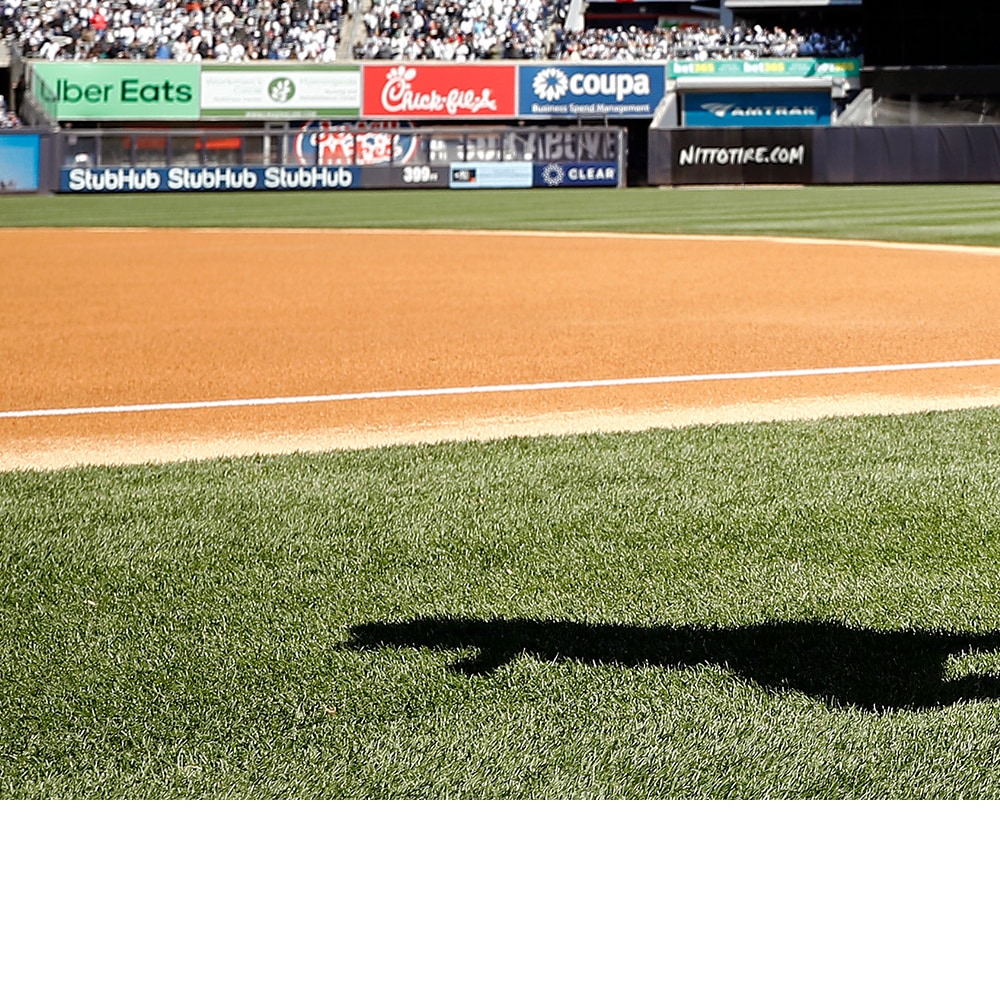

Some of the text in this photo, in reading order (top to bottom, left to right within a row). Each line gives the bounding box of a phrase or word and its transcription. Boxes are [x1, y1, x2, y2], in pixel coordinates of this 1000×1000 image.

[121, 79, 192, 103] Eats
[381, 66, 496, 114] Chick-fil-A
[569, 72, 650, 101] coupa
[569, 103, 595, 114] Spend
[597, 103, 650, 114] Management
[731, 106, 816, 117] AMTRAK
[679, 144, 805, 166] NITTOTIRE.COM
[69, 166, 352, 191] StubHub StubHub StubHub
[568, 168, 615, 180] CLEAR
